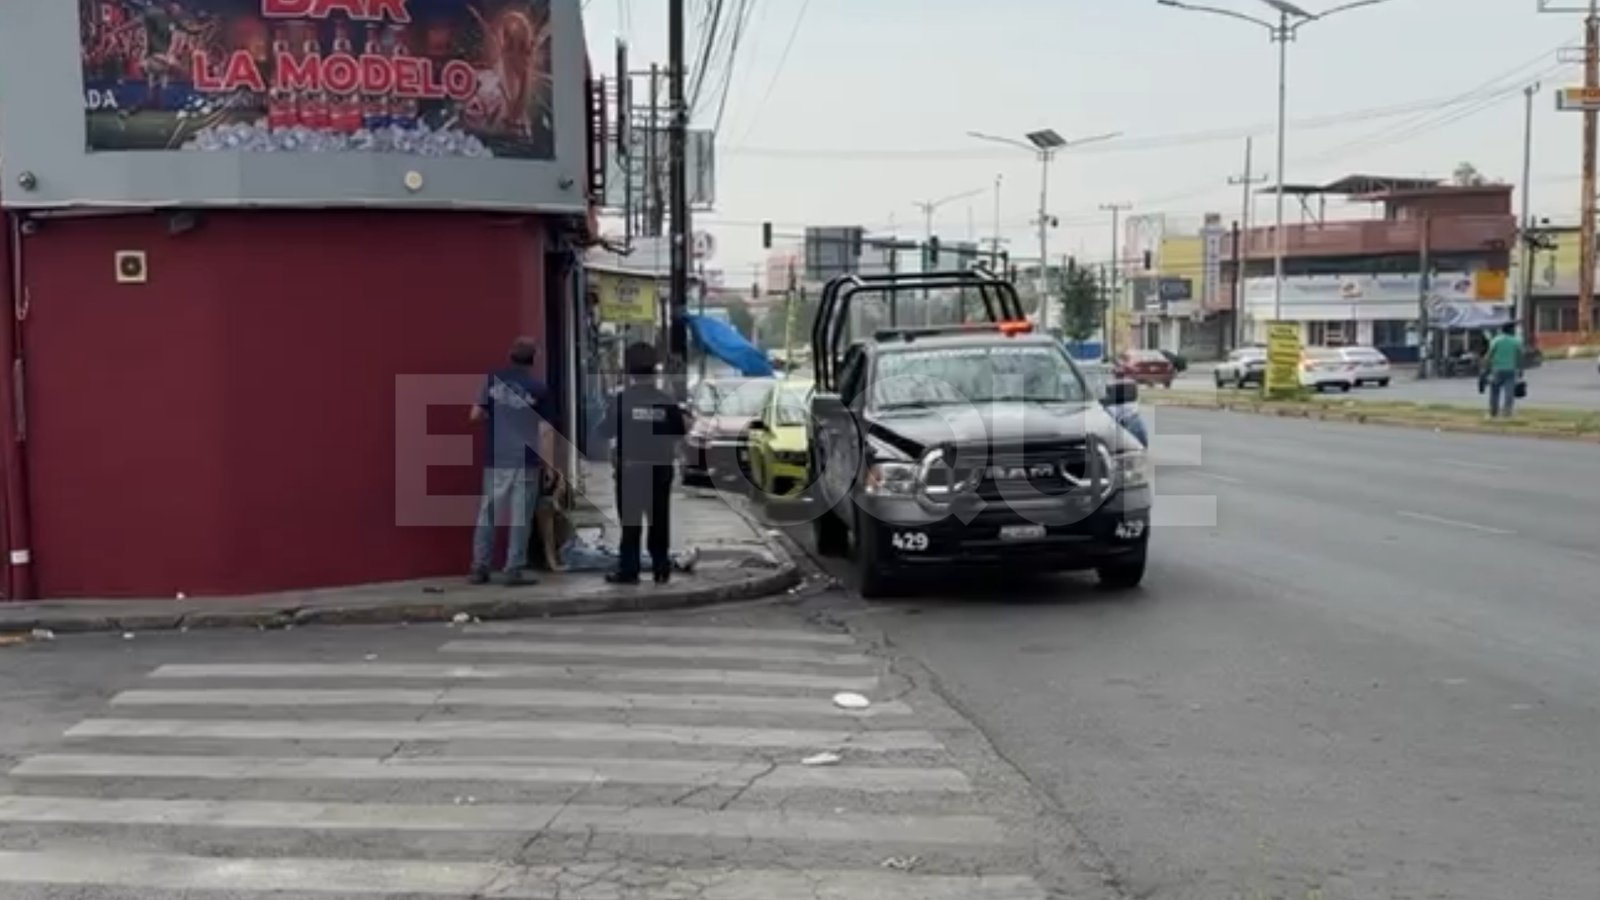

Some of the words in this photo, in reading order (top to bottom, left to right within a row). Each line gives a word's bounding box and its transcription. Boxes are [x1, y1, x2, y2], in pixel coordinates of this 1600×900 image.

[192, 49, 266, 92] LA
[276, 51, 477, 99] MODELO
[84, 88, 118, 109] DA
[1114, 518, 1145, 538] 429
[891, 531, 930, 551] 429
